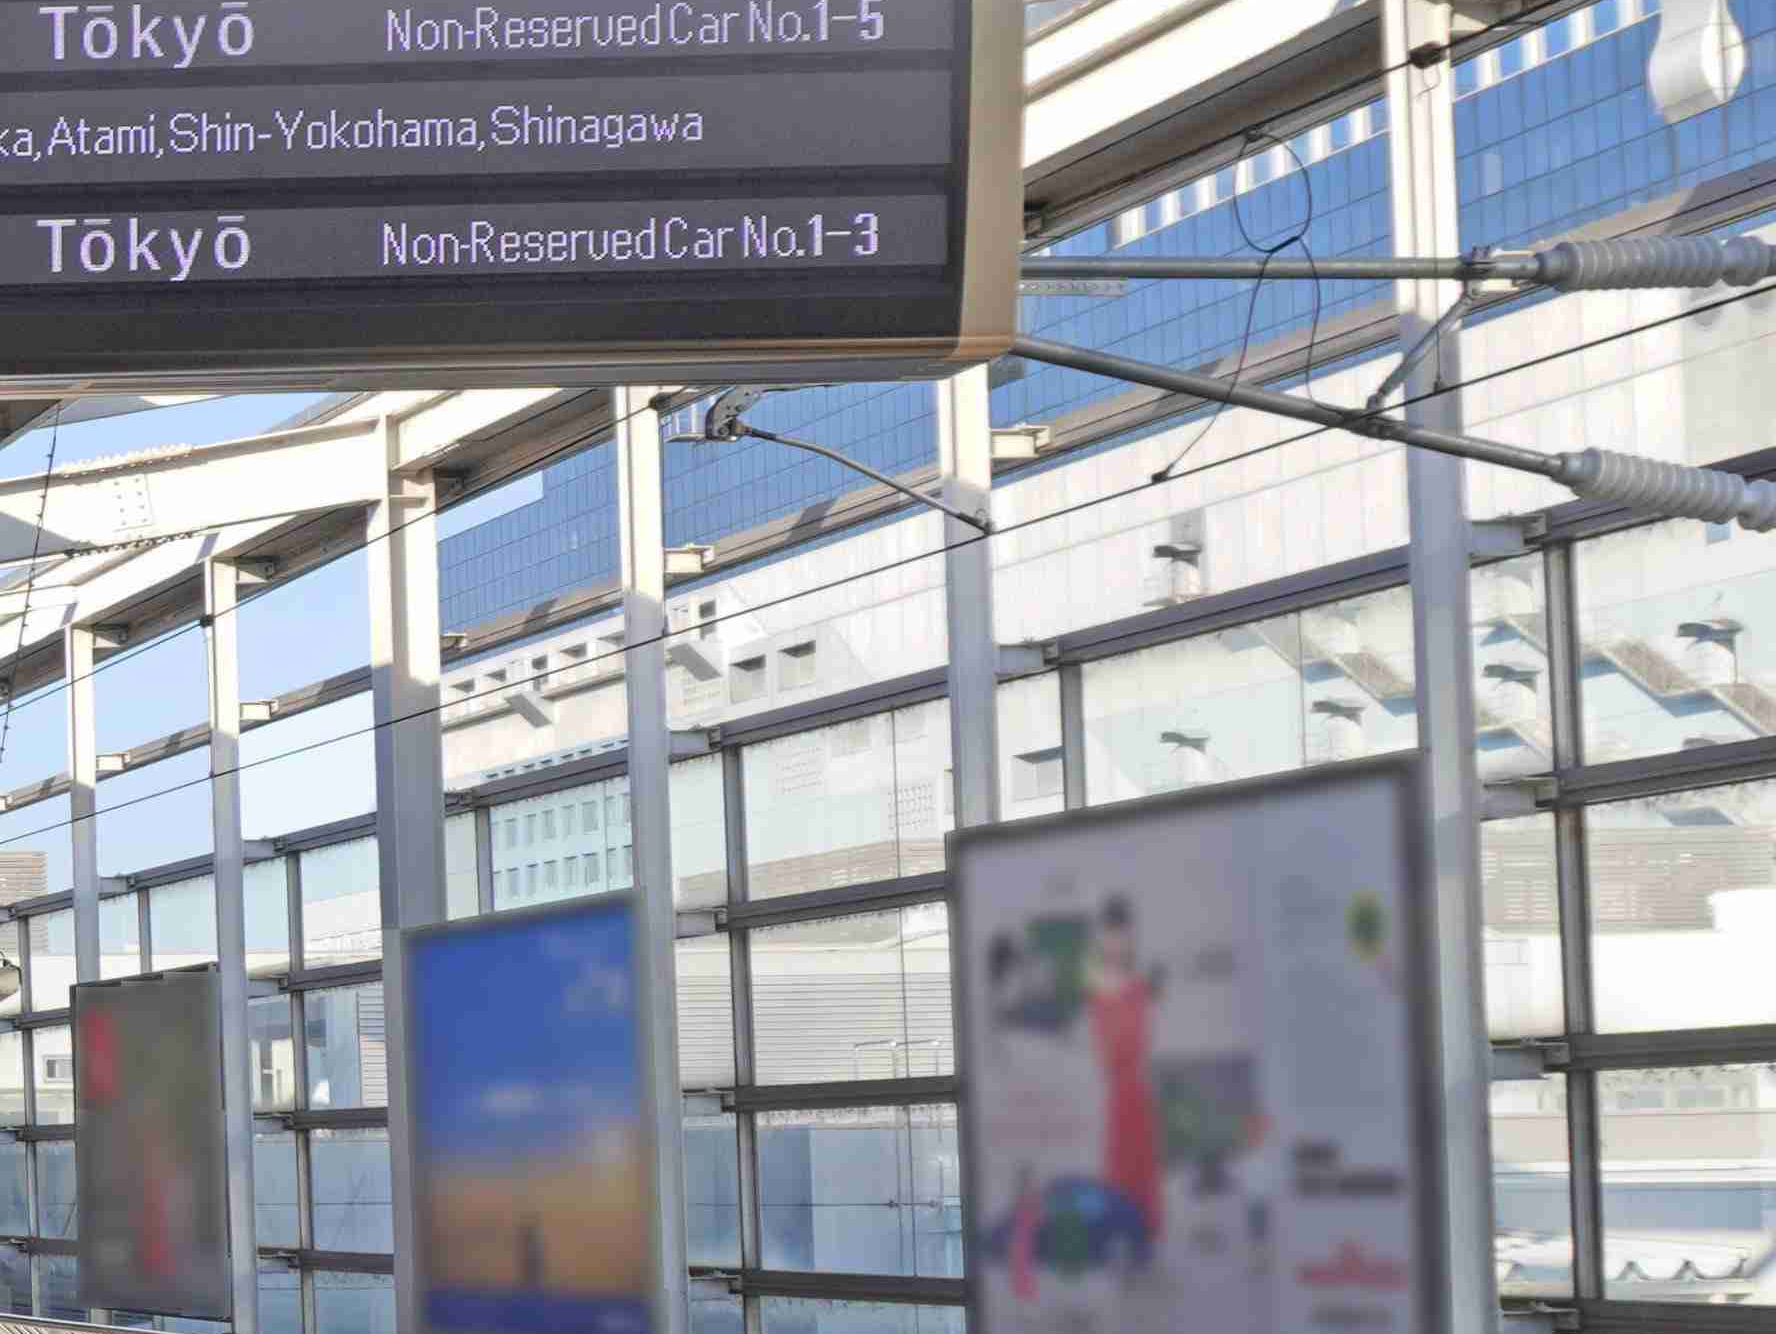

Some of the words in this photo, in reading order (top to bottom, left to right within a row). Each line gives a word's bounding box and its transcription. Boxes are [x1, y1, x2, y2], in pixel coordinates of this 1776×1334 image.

[40, 1, 253, 68] Tōkyō
[671, 2, 737, 47] Car
[37, 215, 250, 283] Tōkyō
[665, 217, 734, 262] Car
